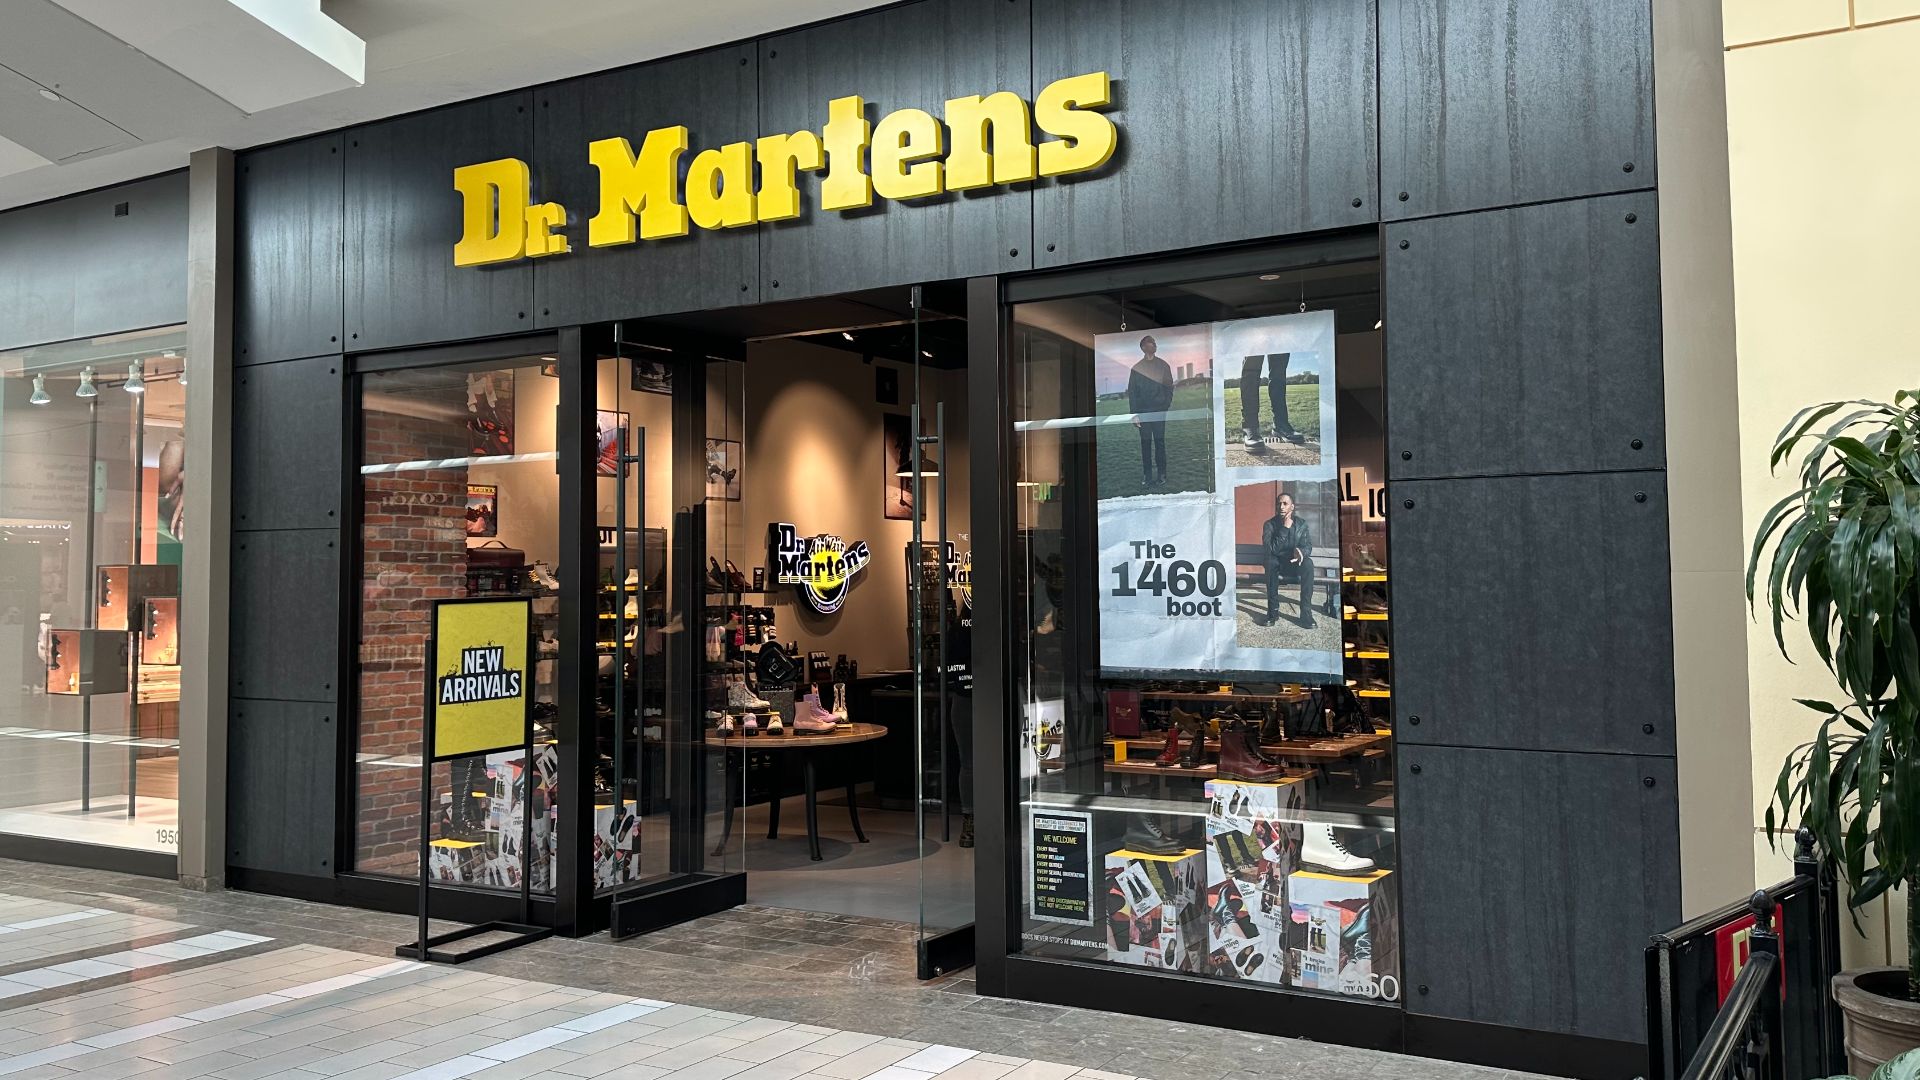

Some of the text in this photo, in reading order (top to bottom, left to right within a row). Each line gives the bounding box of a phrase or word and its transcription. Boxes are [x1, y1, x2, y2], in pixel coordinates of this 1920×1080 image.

[454, 71, 1118, 266] Dr. Martens
[779, 523, 804, 554] Dr.
[1130, 540, 1176, 559] The
[779, 541, 870, 584] Martens
[1111, 560, 1227, 597] 1460
[1167, 597, 1222, 616] boot
[464, 648, 502, 675] NEW
[441, 672, 520, 703] ARRIVALS
[1043, 834, 1077, 845] WE WELCOME
